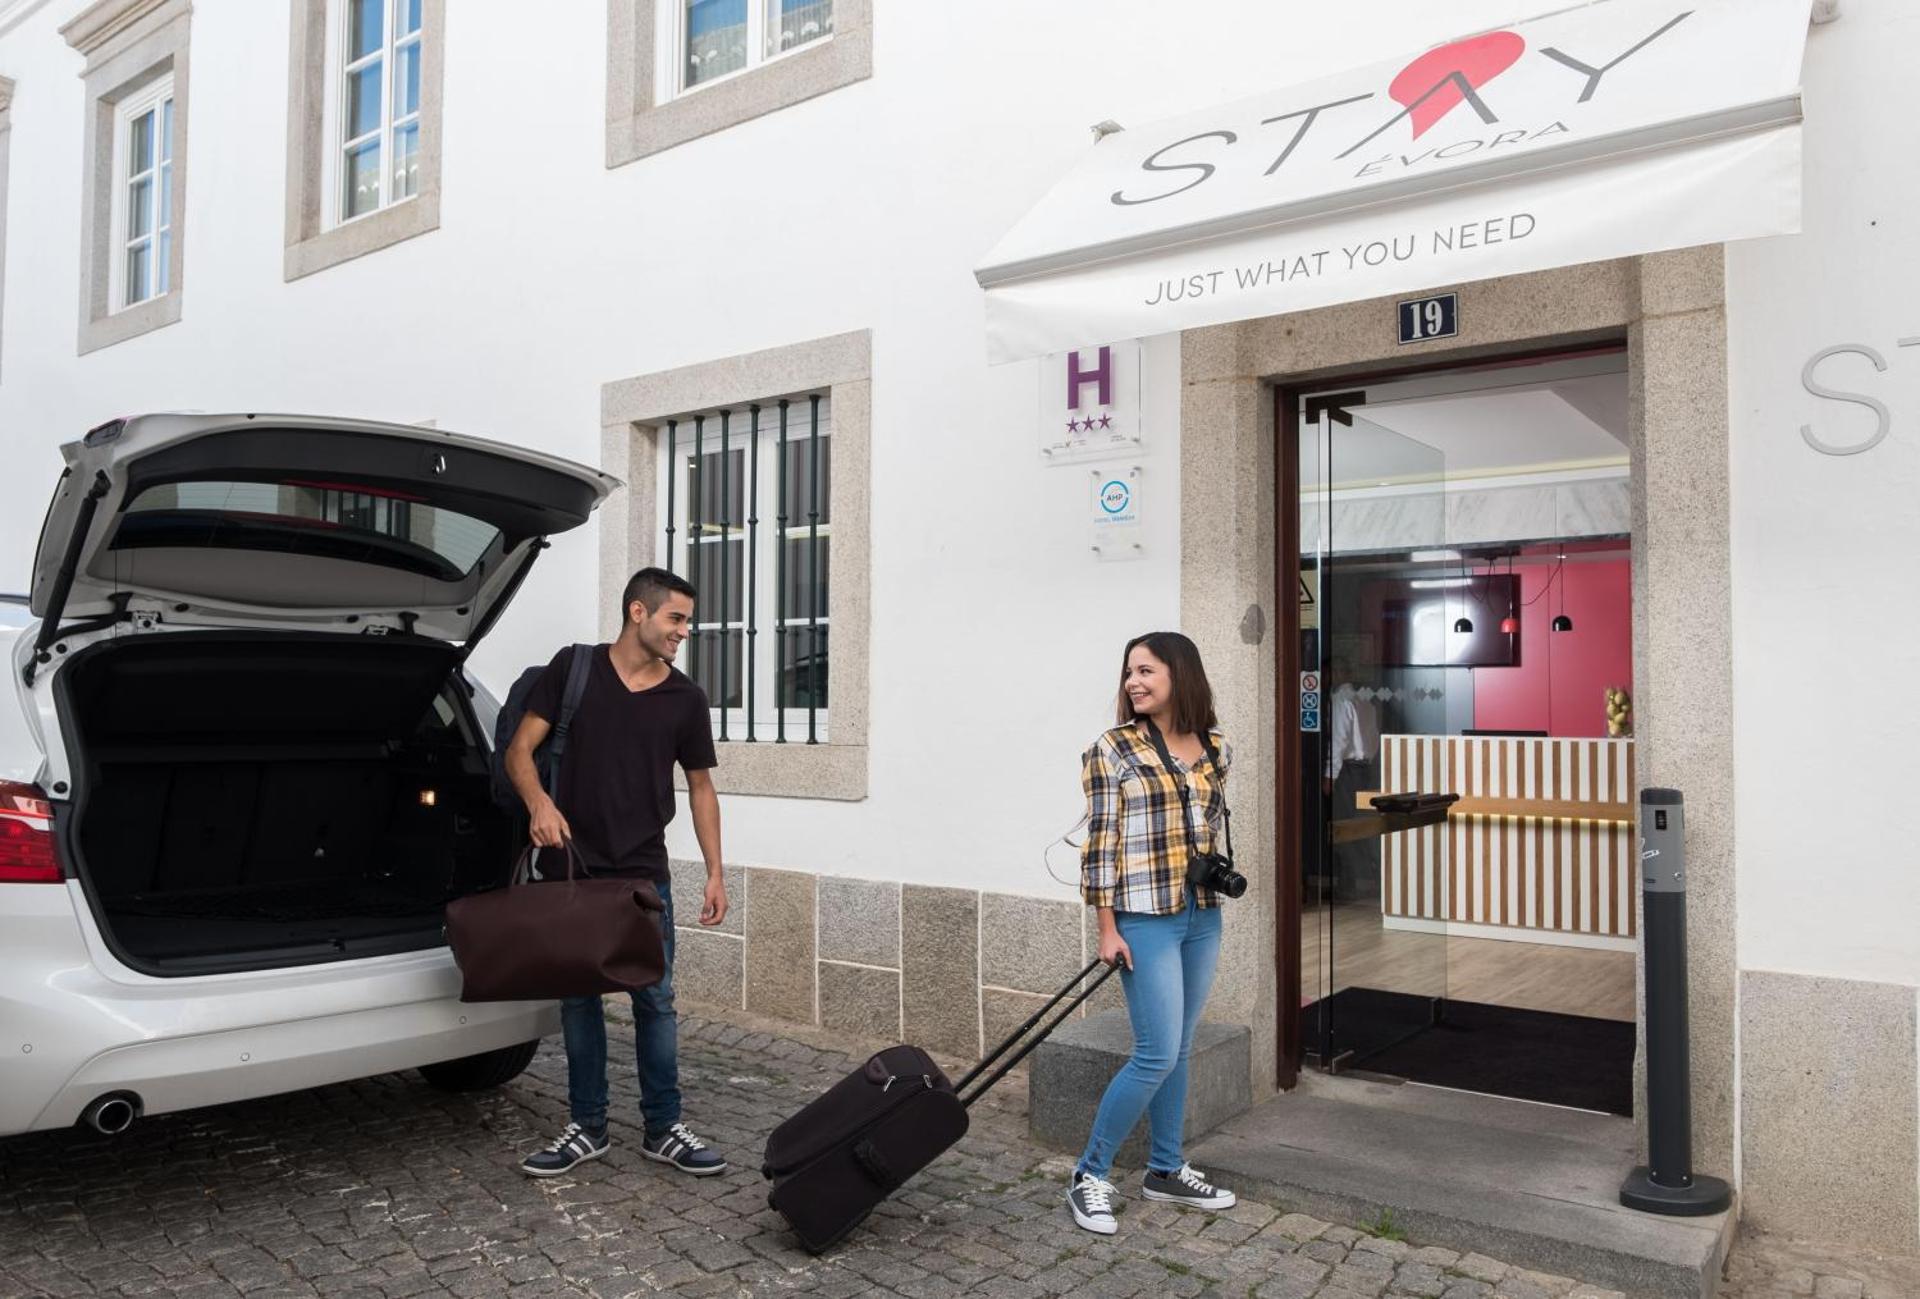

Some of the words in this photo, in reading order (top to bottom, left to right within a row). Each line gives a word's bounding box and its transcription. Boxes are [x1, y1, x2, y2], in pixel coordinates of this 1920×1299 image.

[1110, 10, 1696, 206] STAY
[1354, 121, 1570, 178] ÉVORA
[1144, 271, 1225, 306] JUST
[1235, 250, 1330, 289] WHAT
[1342, 234, 1416, 270] YOU
[1433, 213, 1536, 255] NEED
[1409, 299, 1443, 340] 19
[1067, 346, 1110, 410] H
[1799, 336, 1920, 457] S
